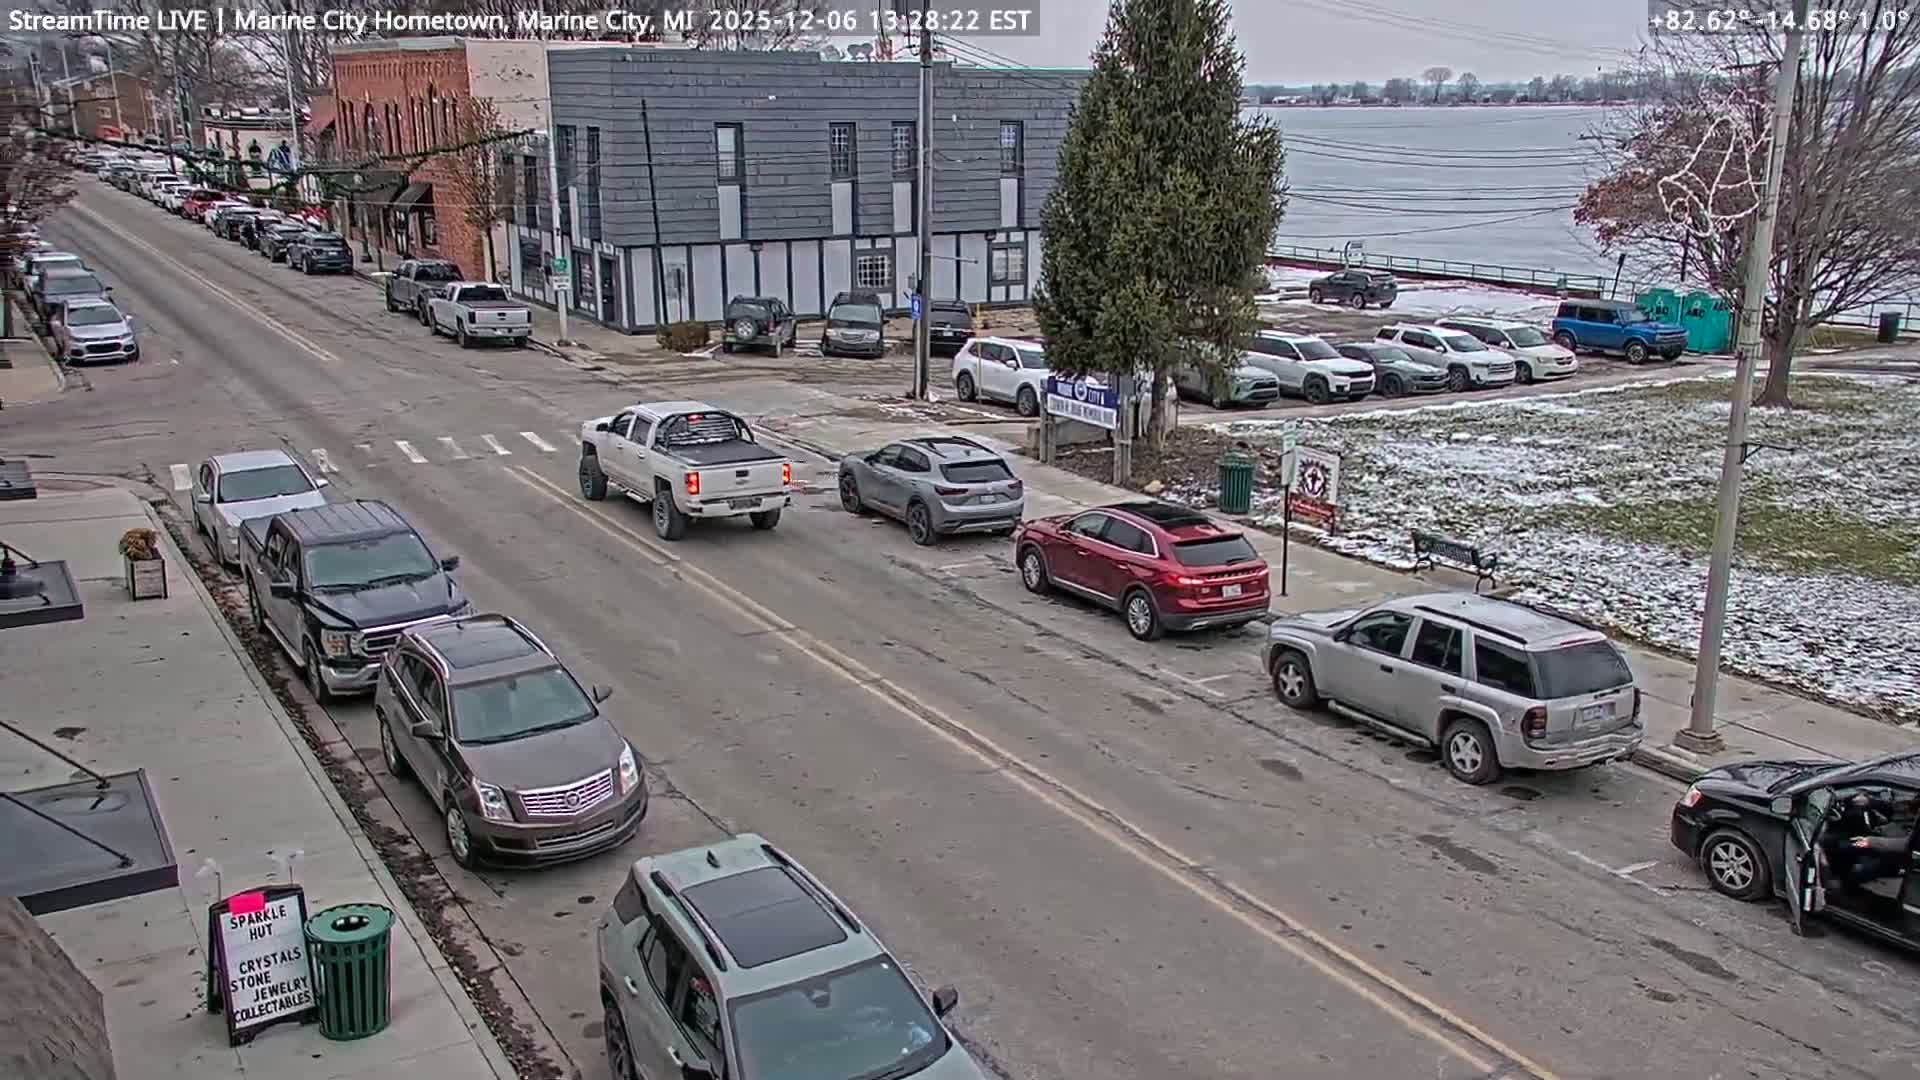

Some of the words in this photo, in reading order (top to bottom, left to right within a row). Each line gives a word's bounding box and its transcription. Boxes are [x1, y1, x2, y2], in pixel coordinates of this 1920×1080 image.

[230, 905, 287, 930] SPARKLE
[249, 923, 273, 941] HUT
[240, 947, 302, 974] CRYSTALS
[230, 971, 272, 993] STONE
[254, 976, 309, 1003] JEWELRY
[234, 991, 311, 1023] COLLECTABLES
